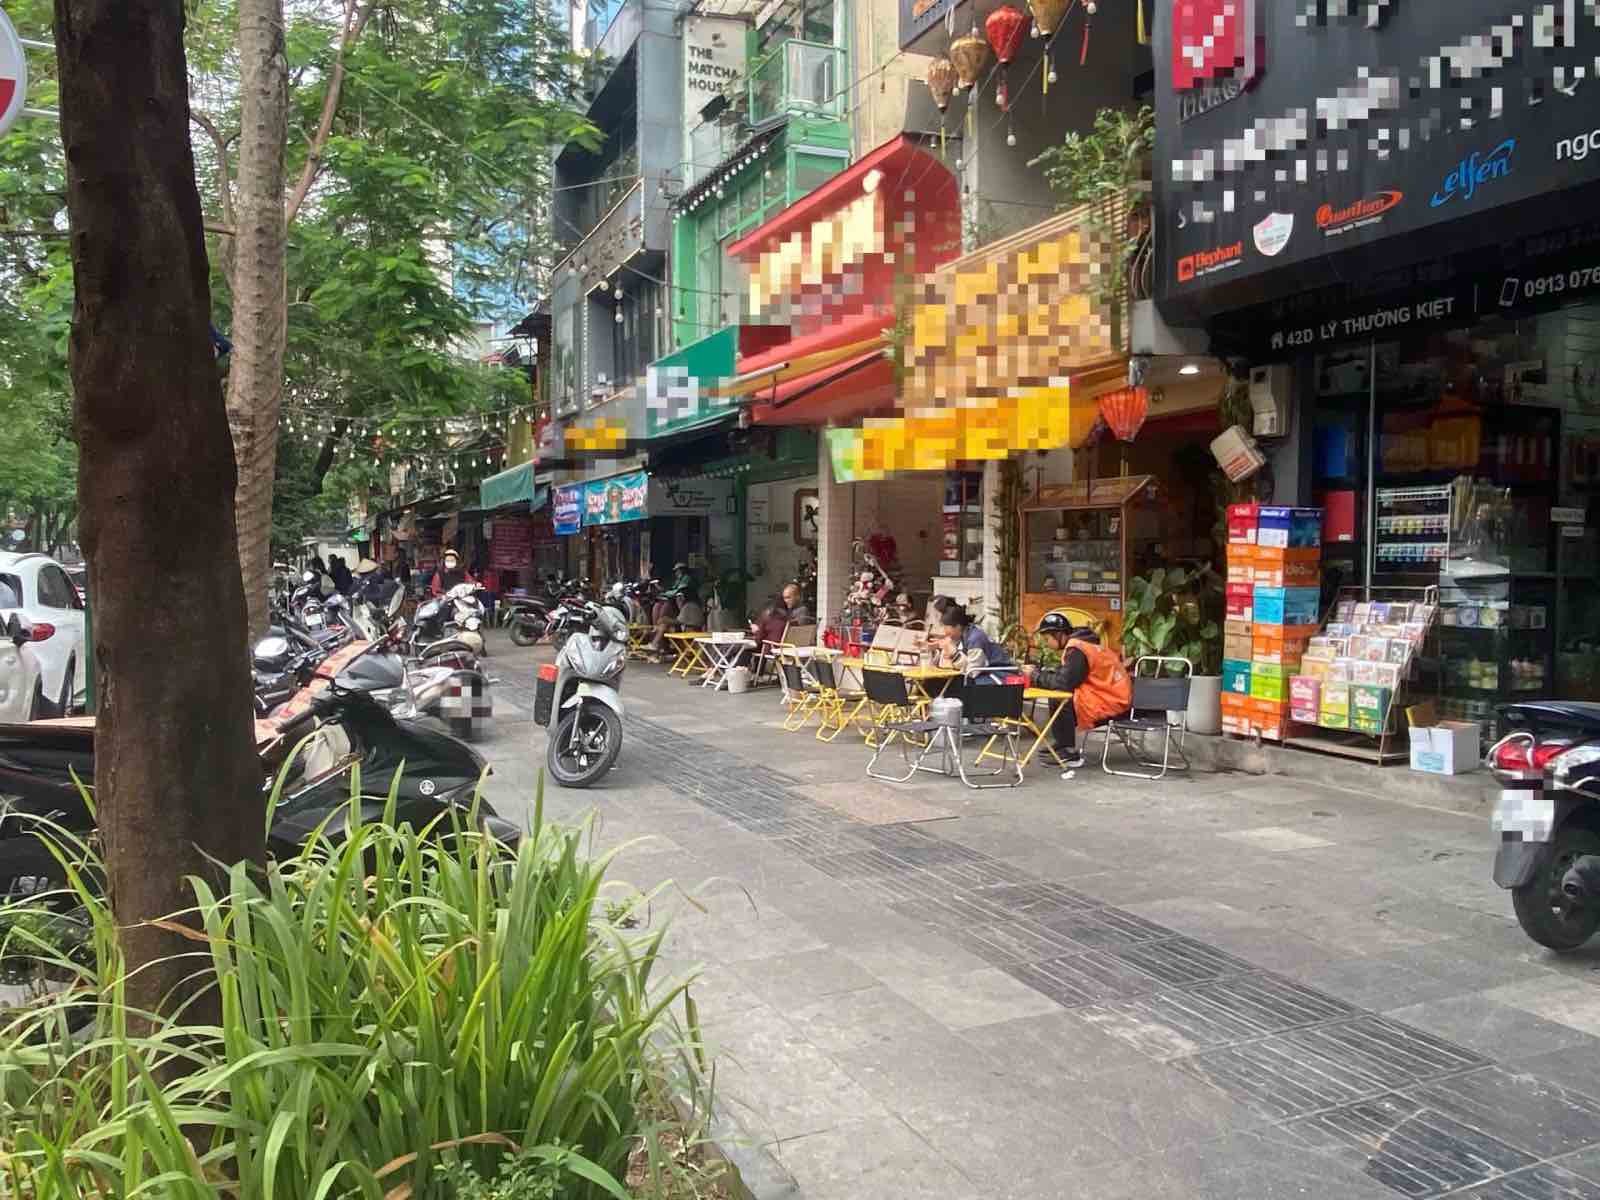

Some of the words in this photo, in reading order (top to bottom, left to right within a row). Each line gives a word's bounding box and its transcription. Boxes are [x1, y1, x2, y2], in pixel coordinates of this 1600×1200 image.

[688, 45, 713, 60] THE
[688, 61, 738, 80] MATCHA
[688, 78, 723, 94] HOUS
[1441, 150, 1513, 200] elfen
[1523, 273, 1566, 297] 0913
[1286, 328, 1313, 346] 42D
